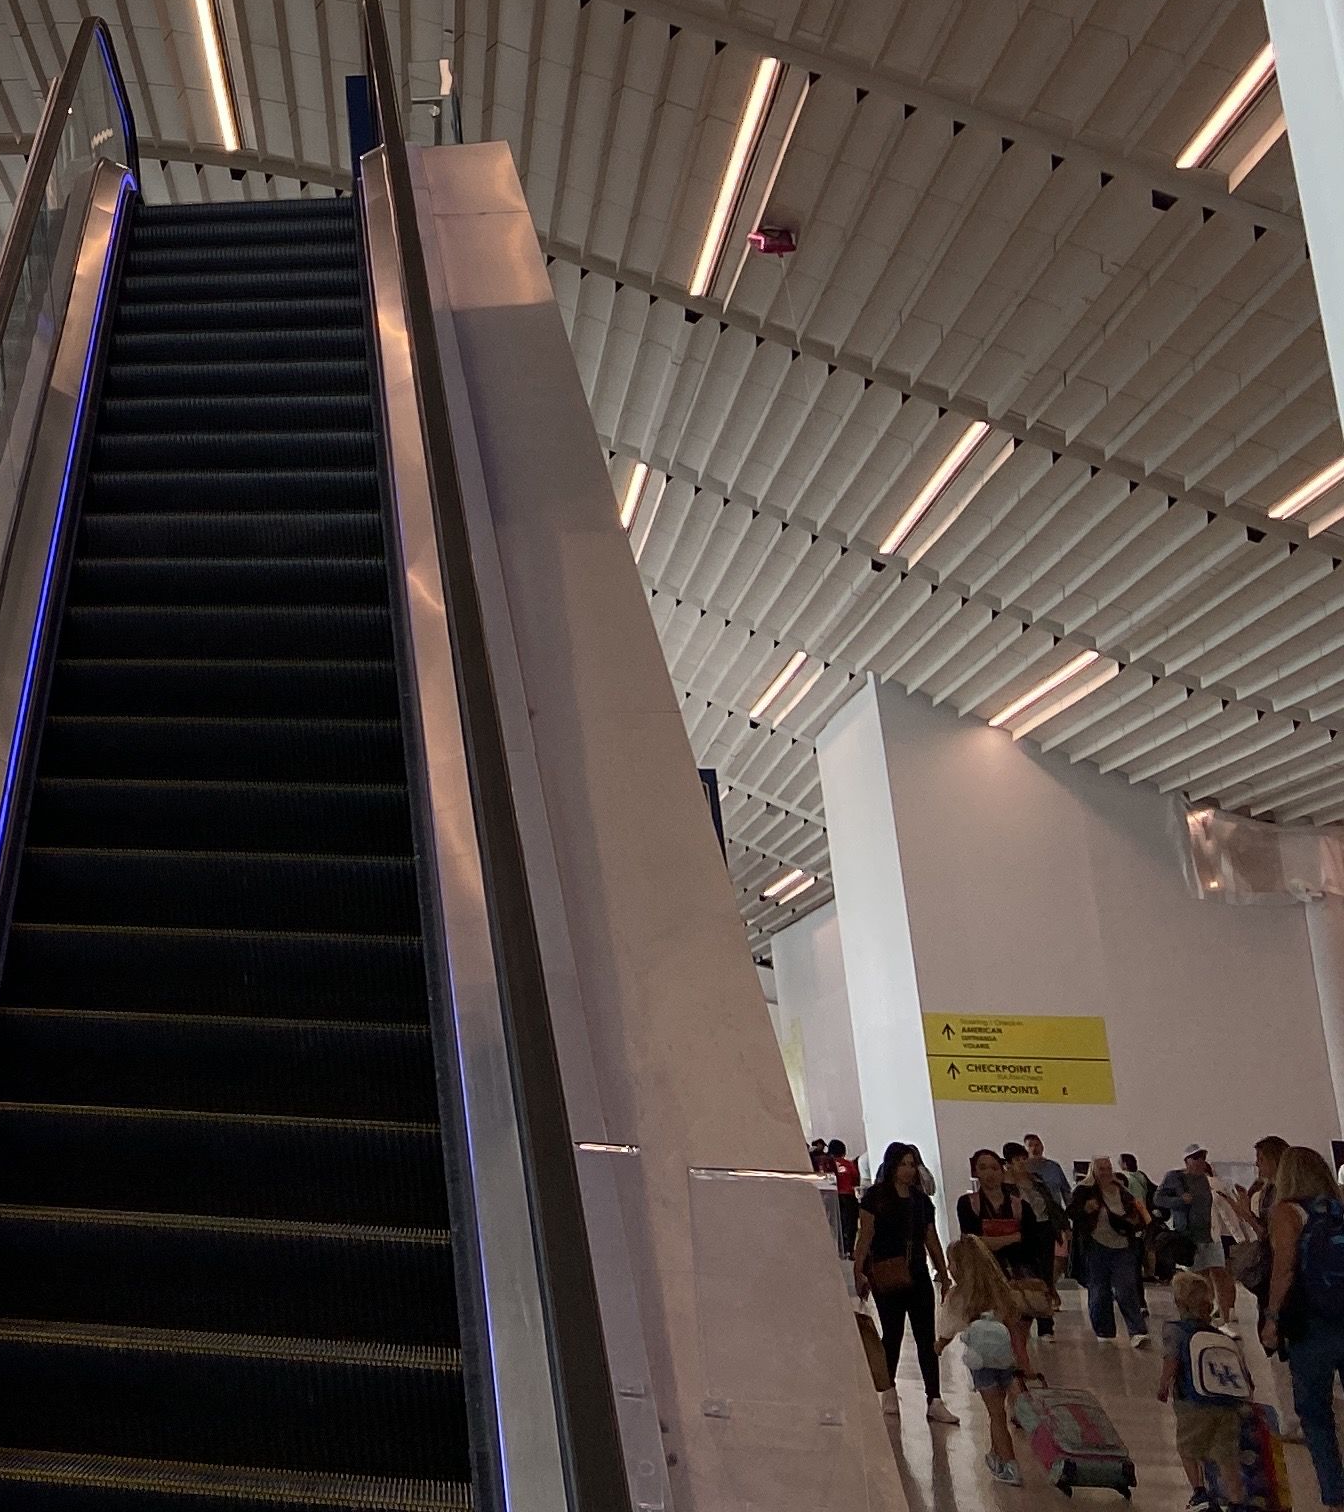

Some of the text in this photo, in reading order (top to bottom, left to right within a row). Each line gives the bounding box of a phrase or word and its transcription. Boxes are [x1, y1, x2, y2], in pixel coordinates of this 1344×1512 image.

[966, 1063, 1044, 1074] CHECKPOINT C
[967, 1083, 1040, 1095] CHECKPOINTS
